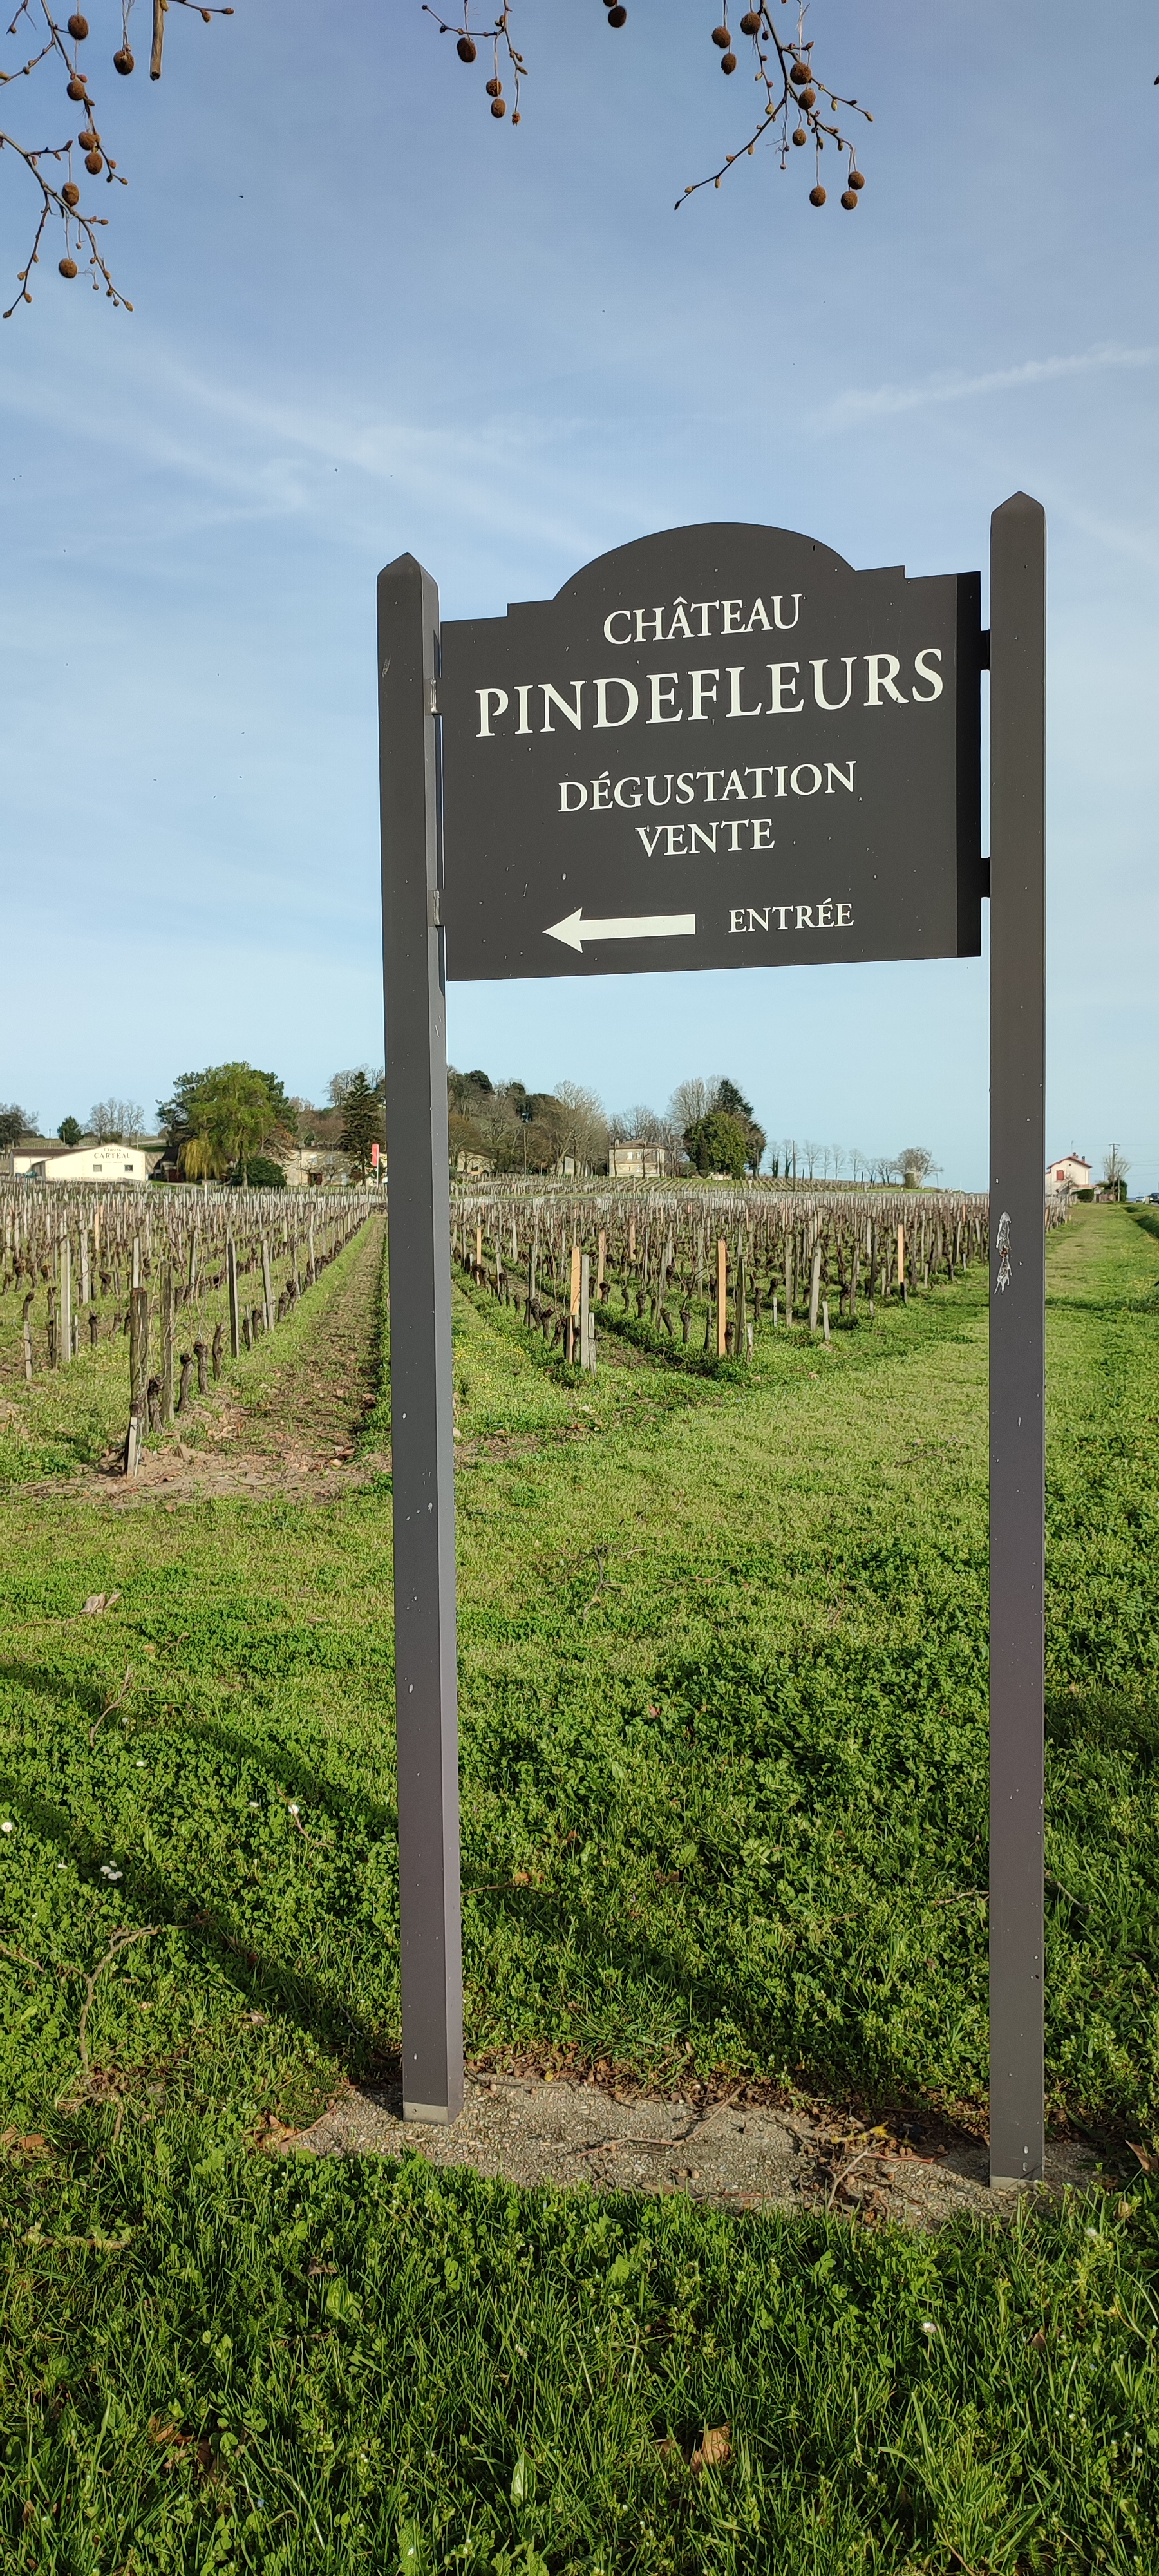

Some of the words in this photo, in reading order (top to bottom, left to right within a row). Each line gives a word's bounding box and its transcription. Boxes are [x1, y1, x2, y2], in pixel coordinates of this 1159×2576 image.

[603, 593, 802, 645] CHÂTEAU
[475, 648, 944, 738] PINDEFLEURS
[558, 761, 857, 813] DÉGUSTATION
[634, 819, 775, 857] VENTE
[728, 898, 855, 934] ENTRÉE
